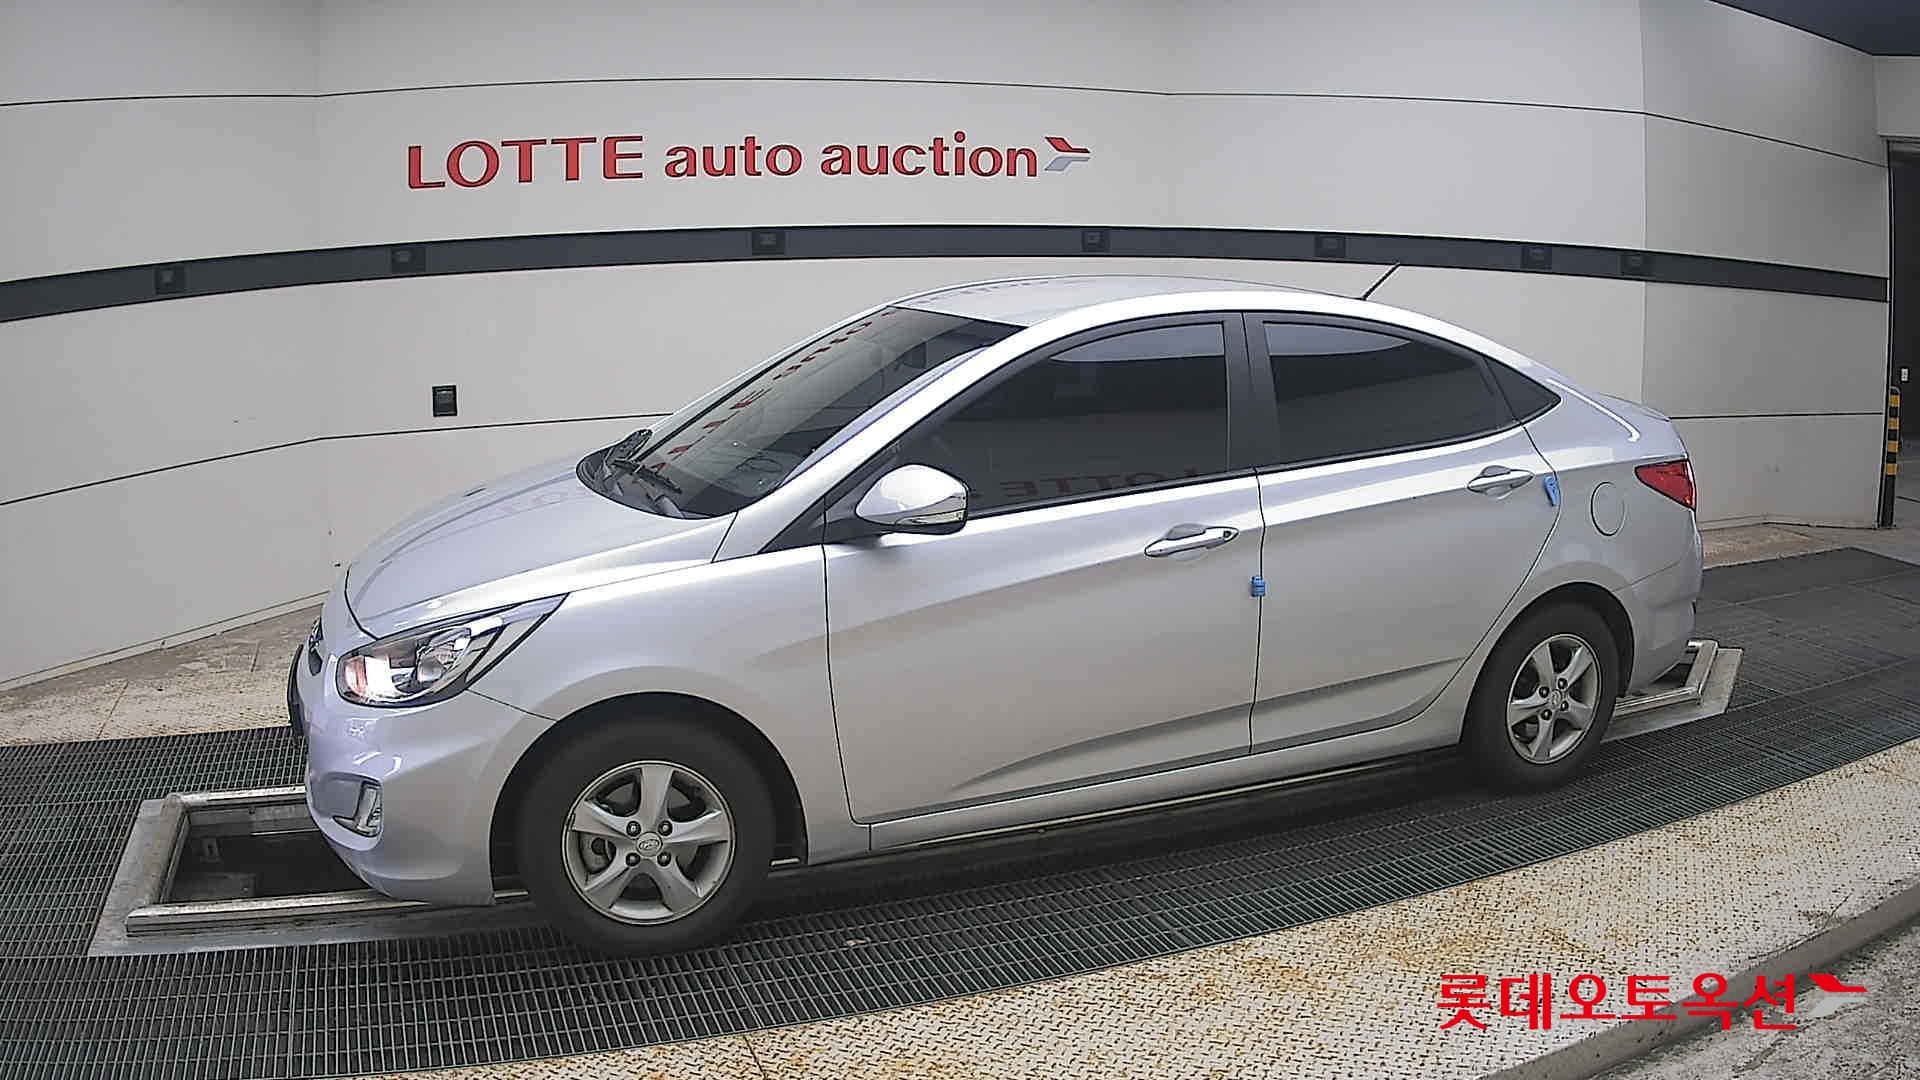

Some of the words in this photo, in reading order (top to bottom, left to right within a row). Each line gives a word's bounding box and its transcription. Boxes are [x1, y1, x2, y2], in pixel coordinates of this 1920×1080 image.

[408, 135, 643, 189] LOTTE
[664, 136, 803, 177] auto
[820, 131, 1038, 176] auction
